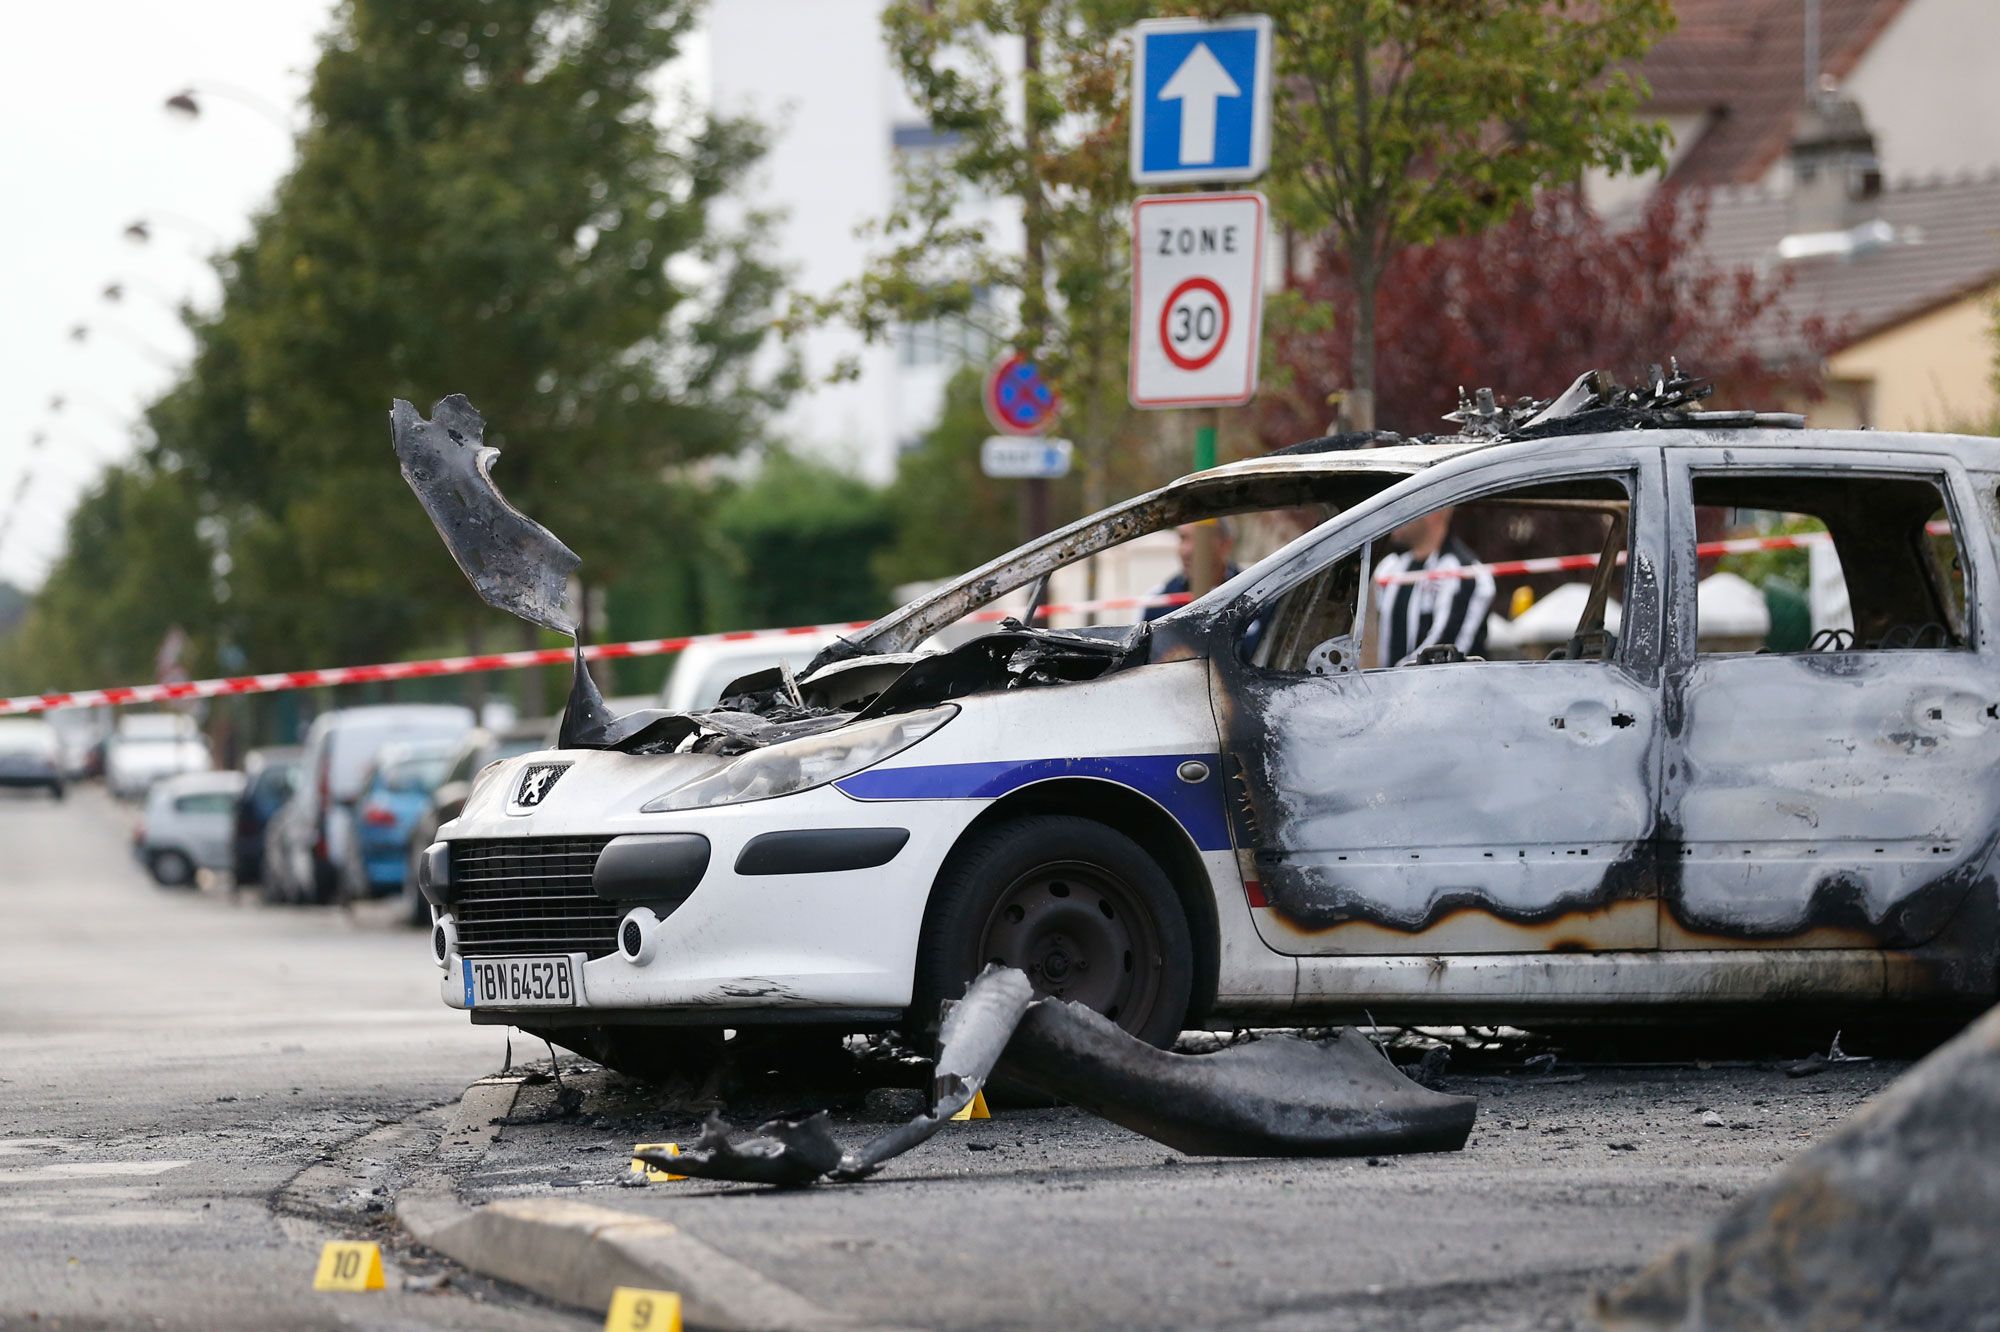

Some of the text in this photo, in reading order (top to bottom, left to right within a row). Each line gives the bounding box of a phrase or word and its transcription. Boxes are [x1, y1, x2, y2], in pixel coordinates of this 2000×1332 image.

[1157, 226, 1238, 256] ZONE
[1174, 305, 1216, 342] 30
[333, 1249, 361, 1279] 10
[630, 1297, 654, 1331] 9
